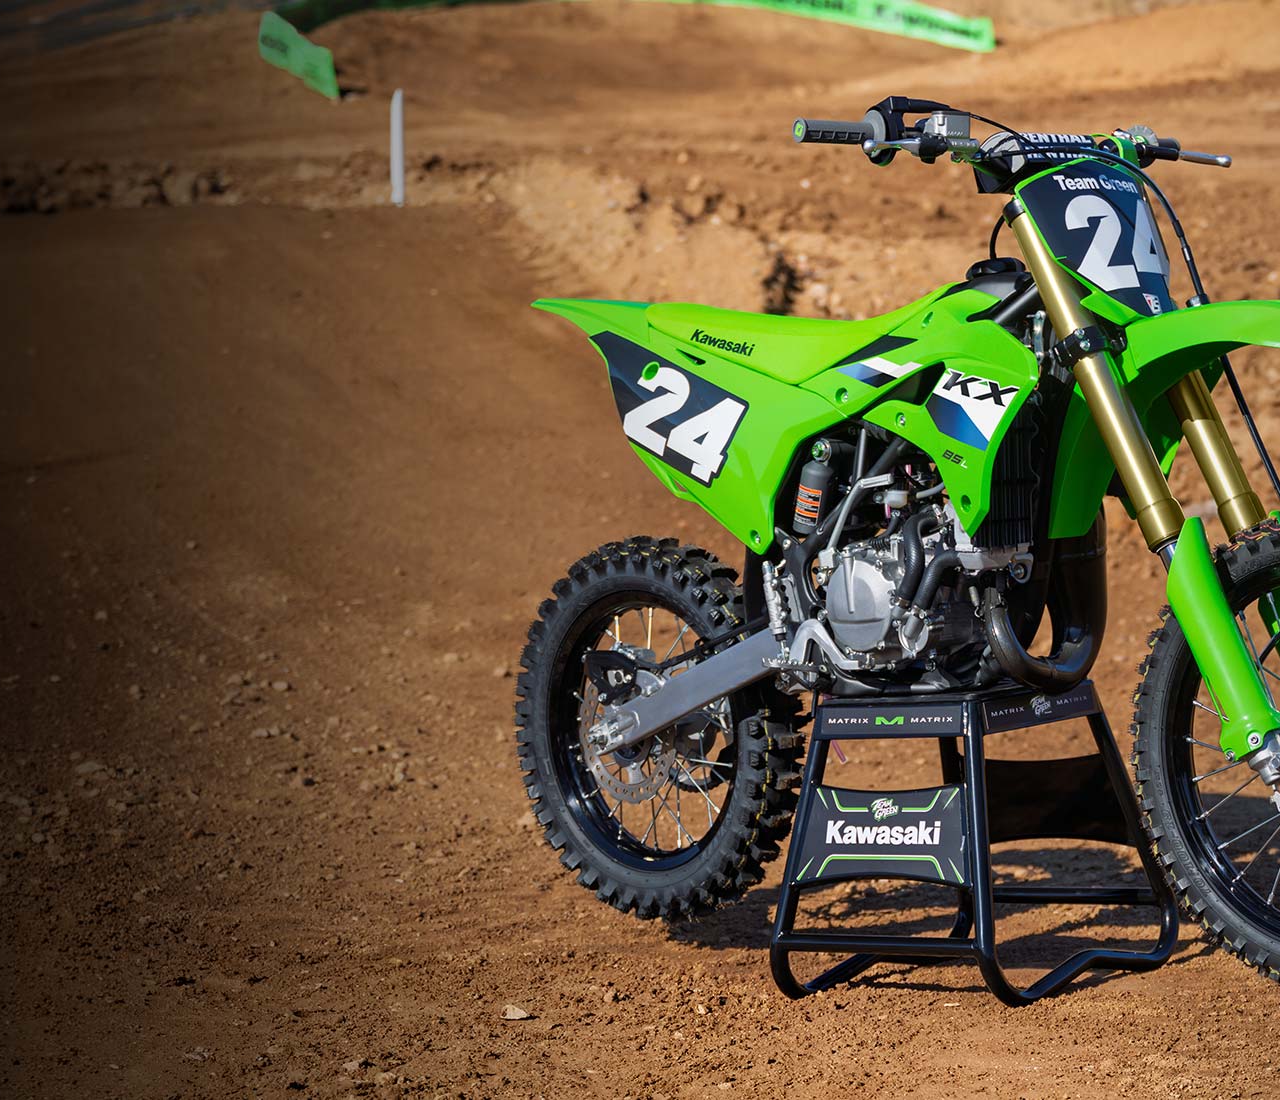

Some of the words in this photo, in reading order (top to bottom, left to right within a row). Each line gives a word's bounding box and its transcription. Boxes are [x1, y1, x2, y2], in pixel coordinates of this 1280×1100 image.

[1052, 174, 1100, 191] Team
[1099, 174, 1138, 194] Green
[1065, 194, 1169, 292] 24
[690, 328, 756, 356] Kawasaki
[942, 370, 1019, 407] KX
[623, 366, 746, 483] 24
[991, 706, 1025, 717] MATRIX
[825, 820, 942, 845] Kawasaki
